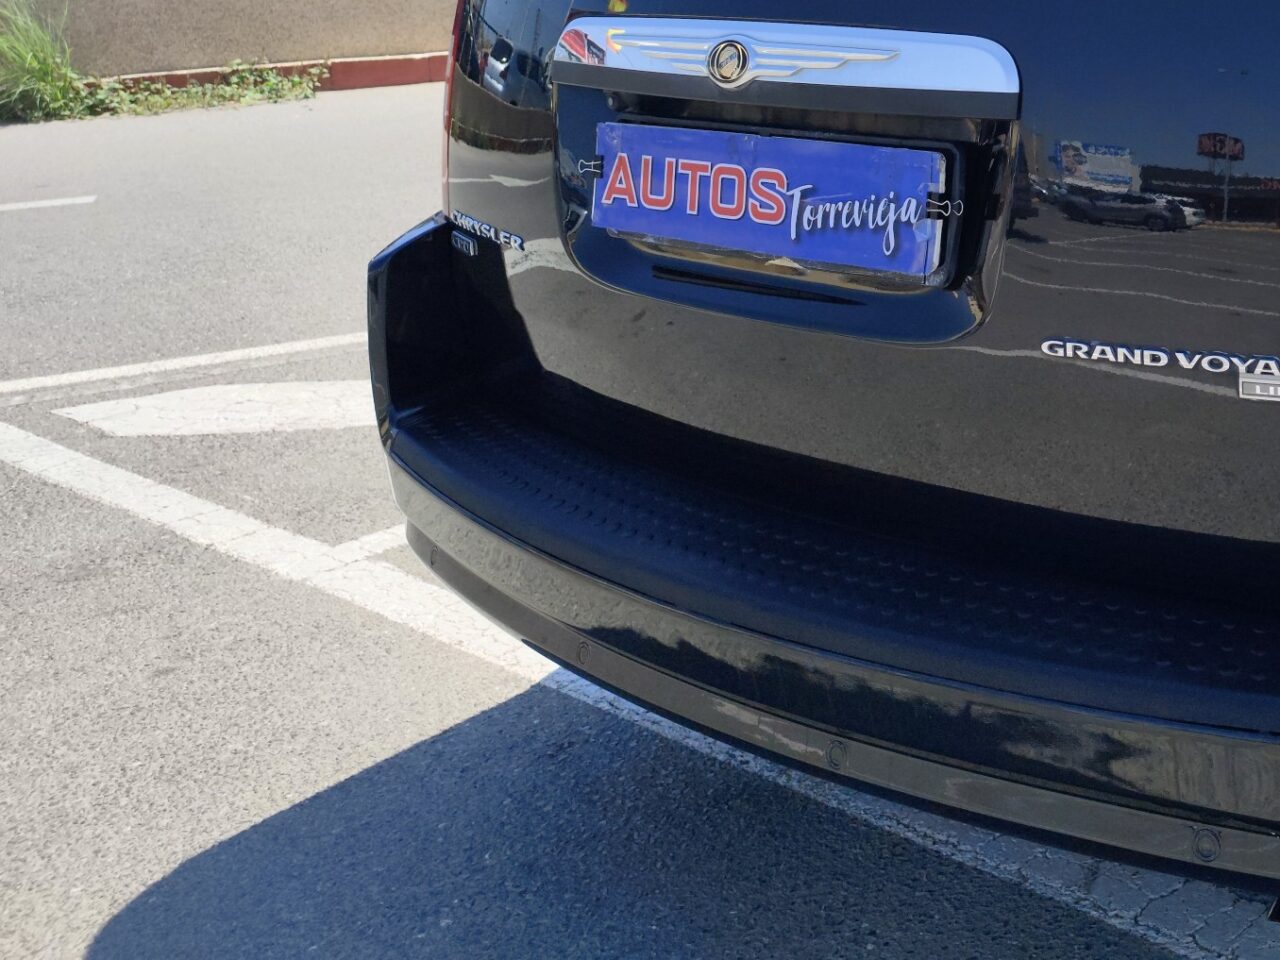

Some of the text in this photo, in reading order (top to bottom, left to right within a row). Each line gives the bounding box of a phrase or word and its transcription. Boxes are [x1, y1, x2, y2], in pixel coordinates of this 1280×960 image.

[601, 152, 923, 256] AUTOS Torrevieja
[451, 210, 526, 252] CHRYSLER
[1040, 339, 1168, 367] GRAND
